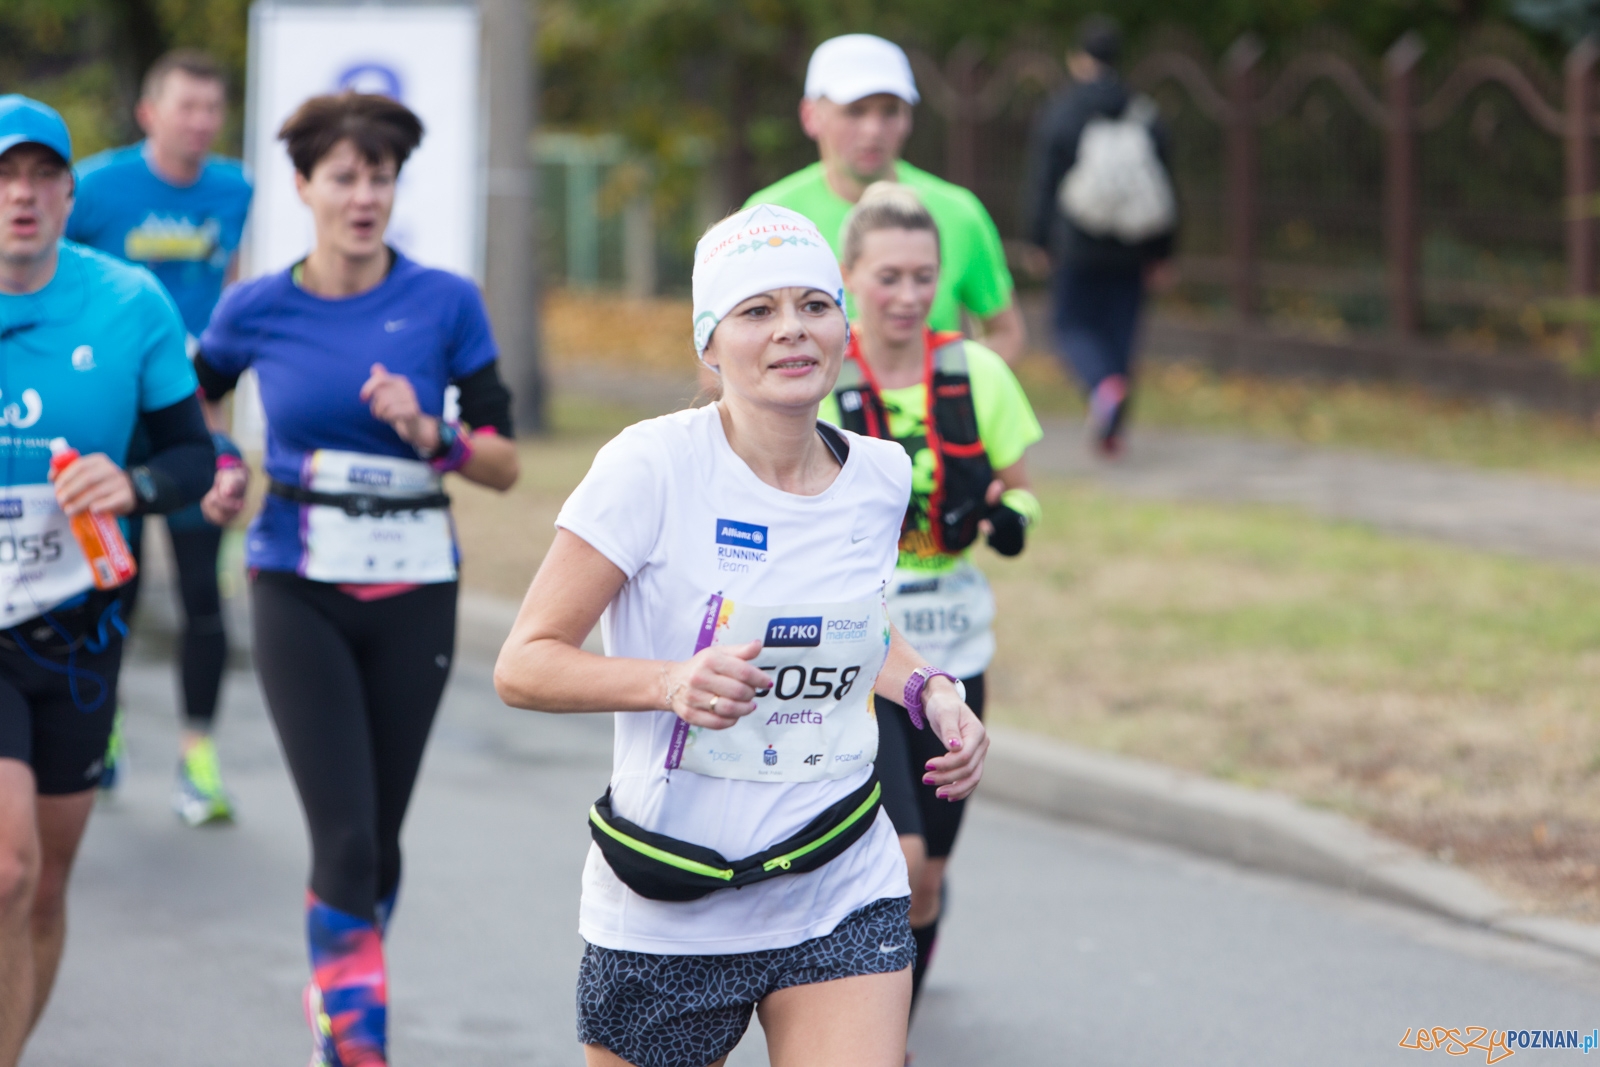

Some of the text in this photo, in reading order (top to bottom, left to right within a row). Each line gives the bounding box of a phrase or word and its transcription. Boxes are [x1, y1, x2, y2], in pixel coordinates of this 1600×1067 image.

[721, 526, 752, 541] Allianz
[717, 546, 767, 563] RUNNING
[717, 557, 750, 574] Team
[770, 624, 819, 639] 17. PKO
[825, 629, 868, 641] maraton
[765, 709, 823, 726] Anetta
